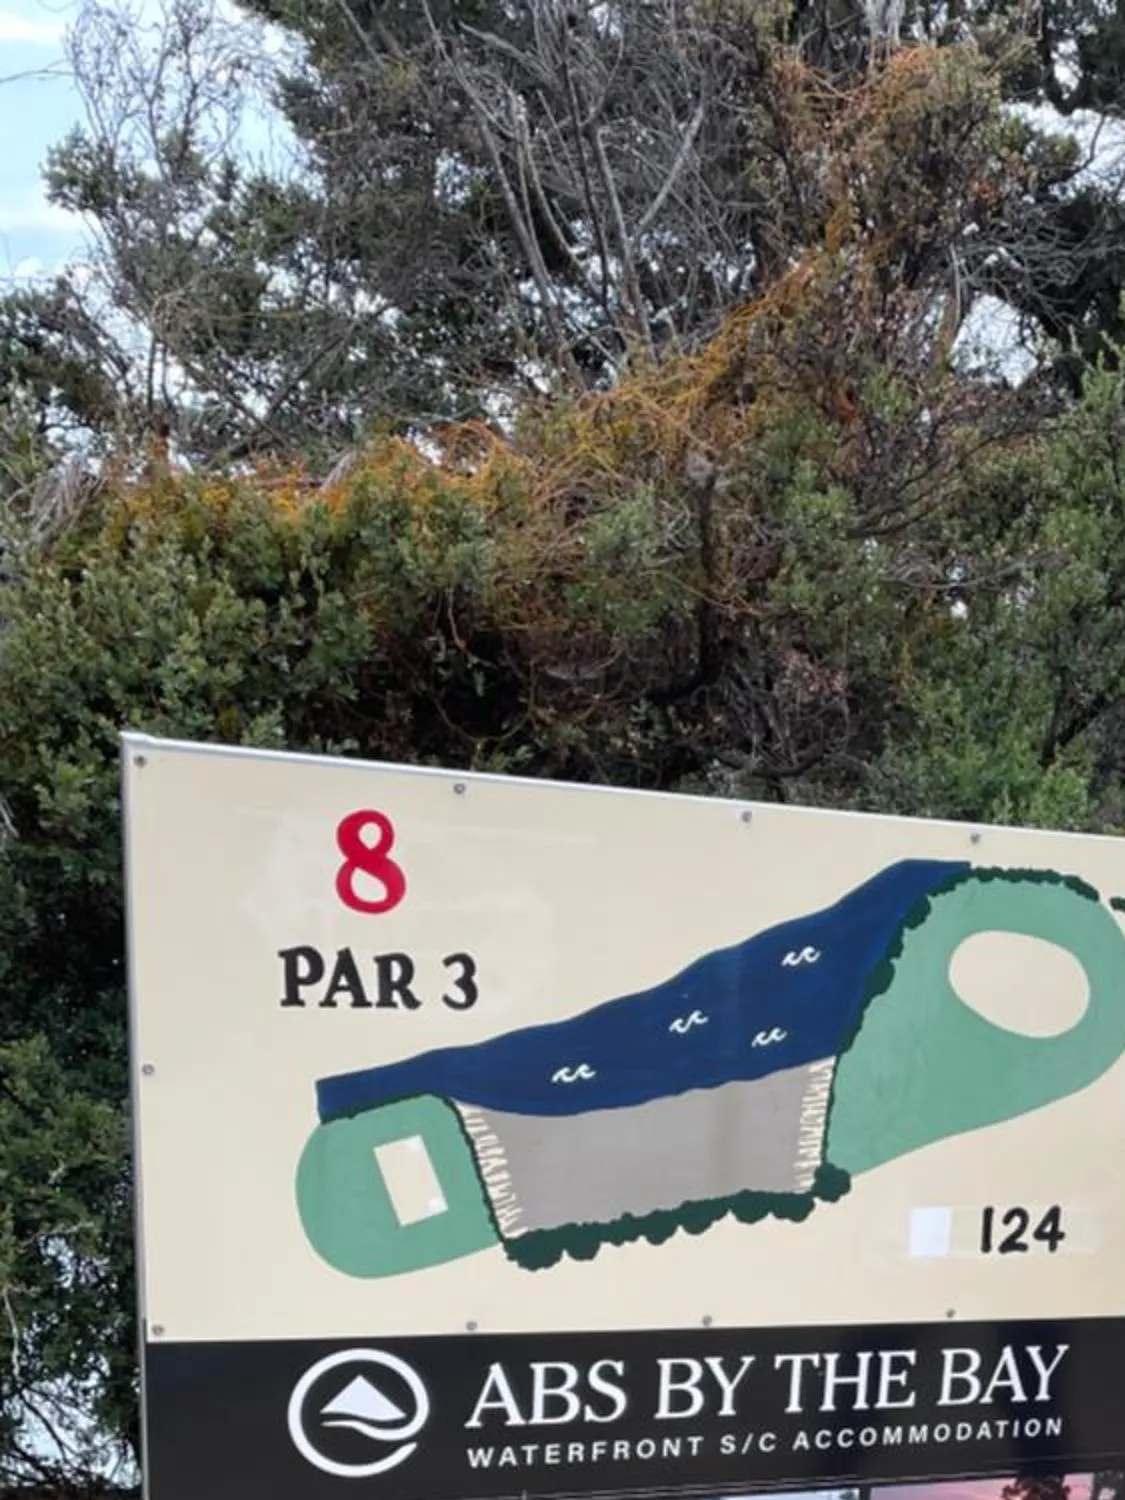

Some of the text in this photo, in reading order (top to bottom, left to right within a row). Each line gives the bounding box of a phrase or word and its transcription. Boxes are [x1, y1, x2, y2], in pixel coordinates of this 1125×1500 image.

[336, 809, 406, 914] 8
[278, 944, 479, 1011] PAR 3
[980, 1205, 1067, 1254] 124
[465, 1344, 1070, 1429] ABS BY THE BAY
[466, 1417, 1065, 1470] WATERFRONT S/C ACCOMMODATION
